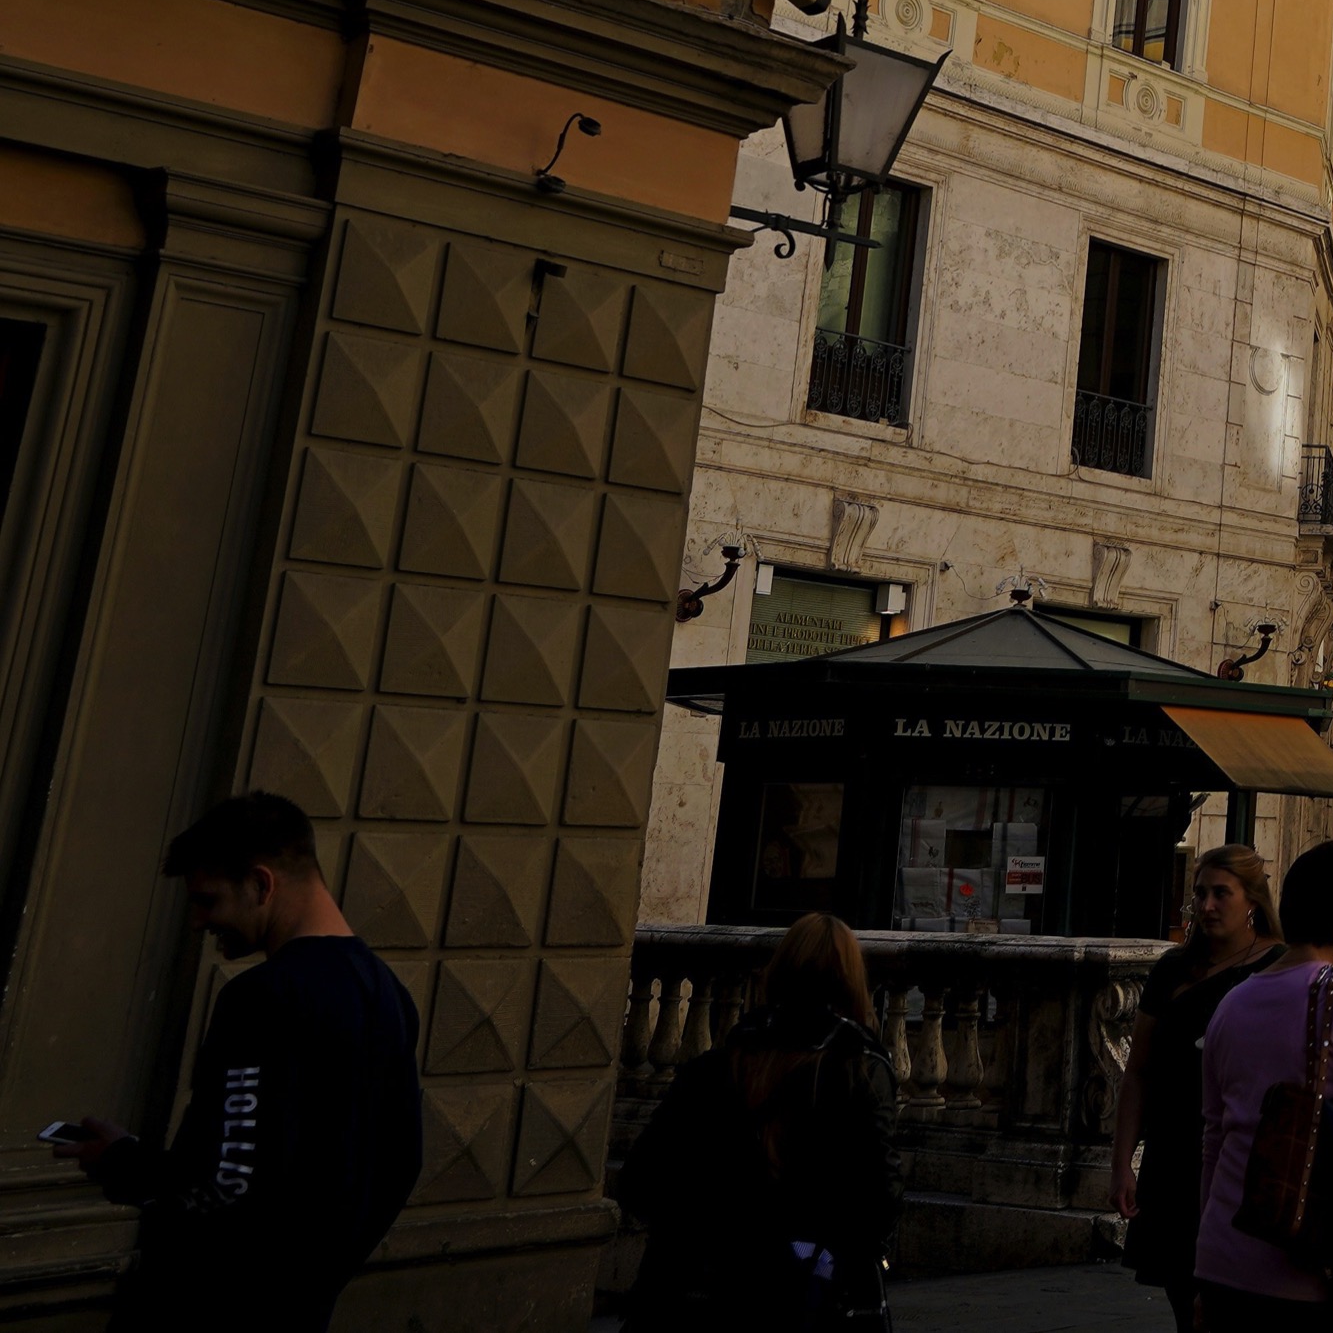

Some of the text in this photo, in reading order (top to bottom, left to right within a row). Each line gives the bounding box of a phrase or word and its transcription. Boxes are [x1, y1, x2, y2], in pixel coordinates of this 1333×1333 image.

[738, 719, 845, 739] LA NAZIONE
[894, 718, 1071, 741] LA NAZIONE
[1122, 726, 1150, 745] LA
